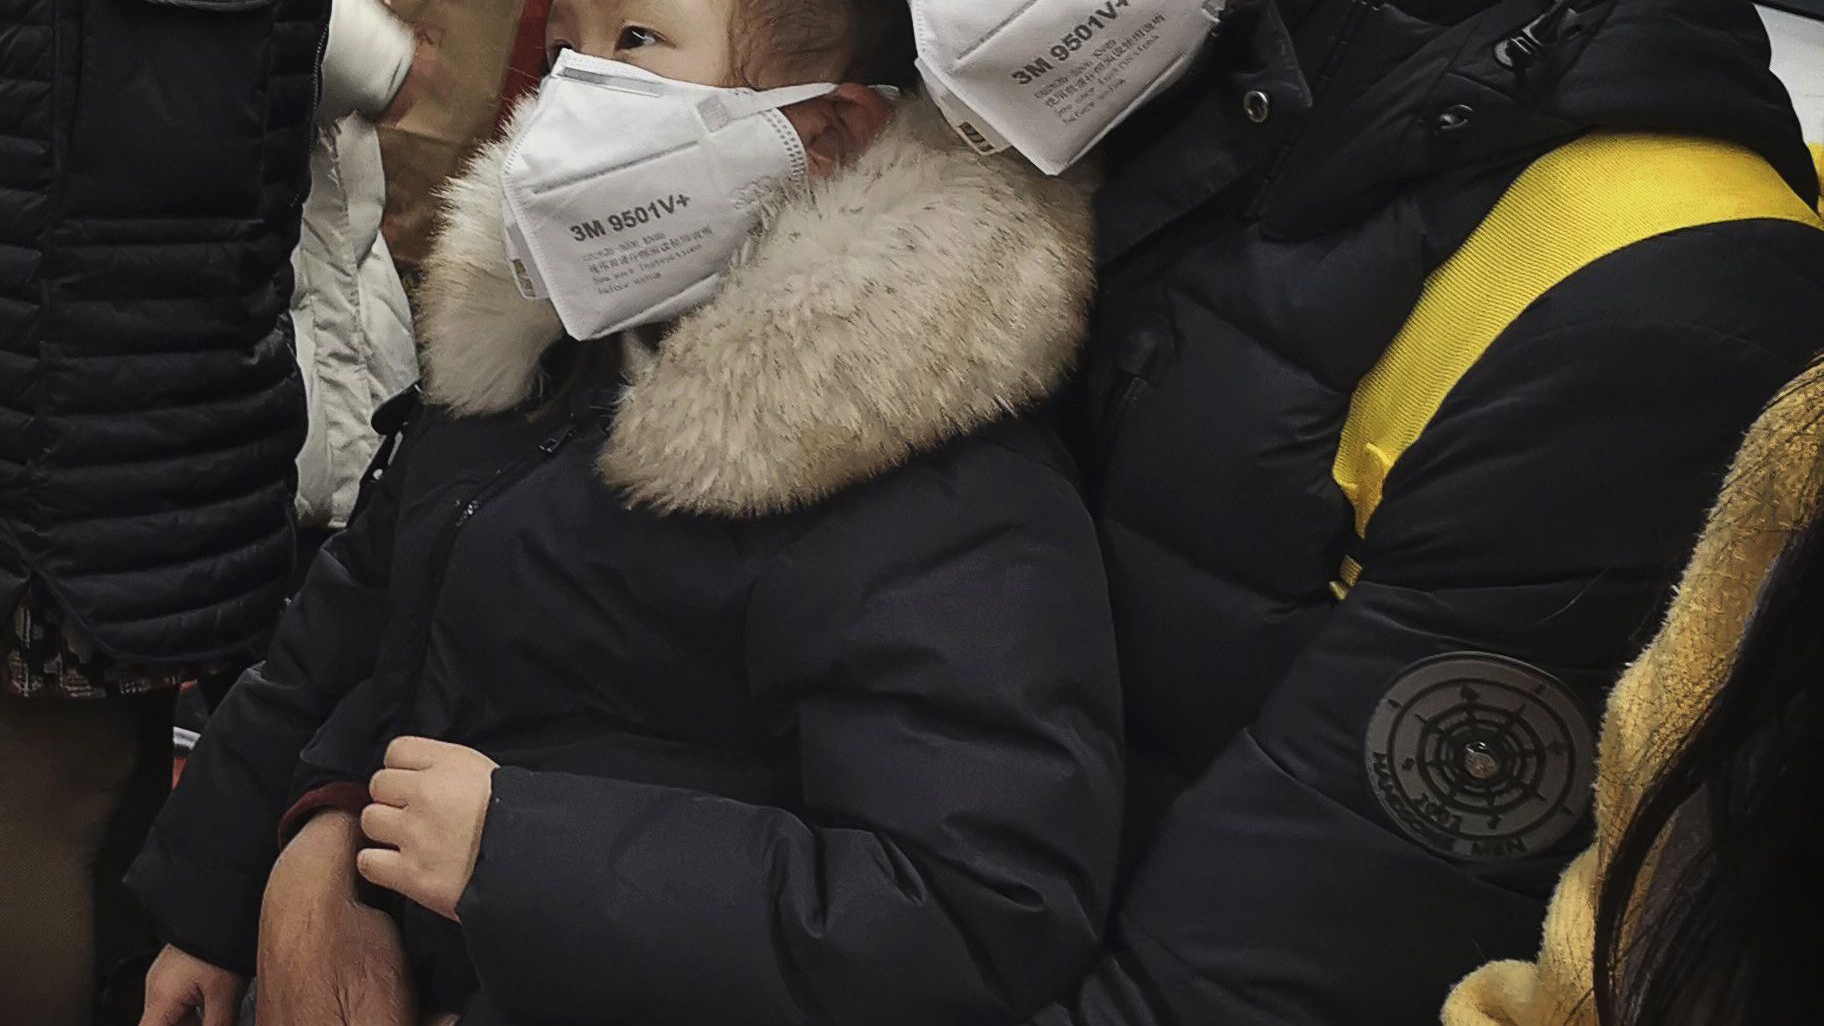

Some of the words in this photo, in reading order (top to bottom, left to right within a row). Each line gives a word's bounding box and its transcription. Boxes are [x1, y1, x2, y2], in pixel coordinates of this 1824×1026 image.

[1010, 57, 1055, 85] 3M
[570, 220, 606, 241] 3M
[608, 194, 691, 232] 9501V+
